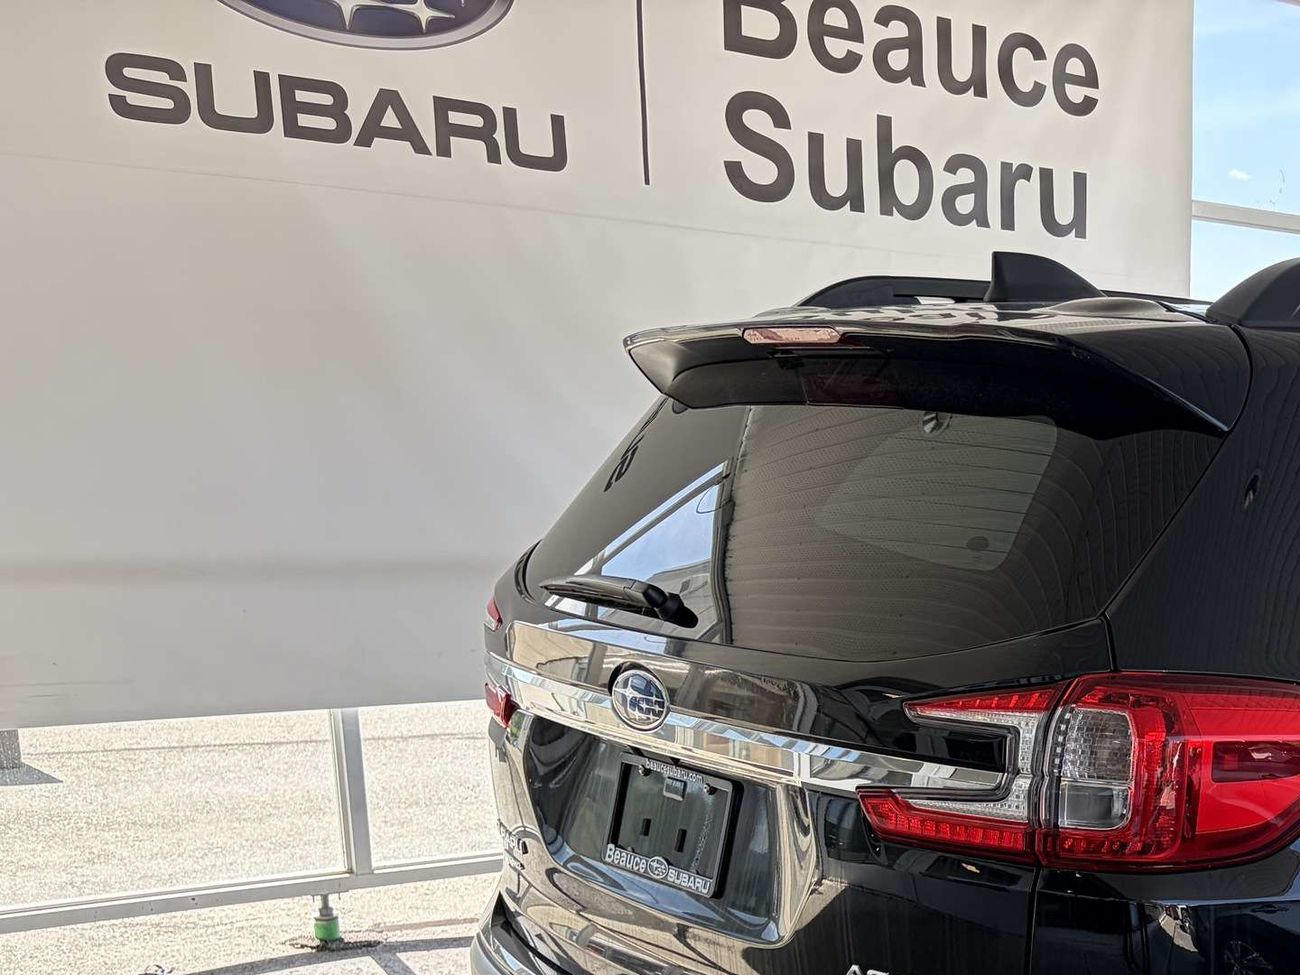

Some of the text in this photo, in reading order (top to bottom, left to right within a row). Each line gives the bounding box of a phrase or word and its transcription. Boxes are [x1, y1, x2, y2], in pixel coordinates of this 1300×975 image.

[104, 52, 568, 172] SUBARU
[723, 0, 1100, 117] Beauce
[723, 91, 1088, 240] Subaru
[645, 758, 704, 784] beaucesubaru.com
[605, 843, 710, 893] Beauce SUBARU
